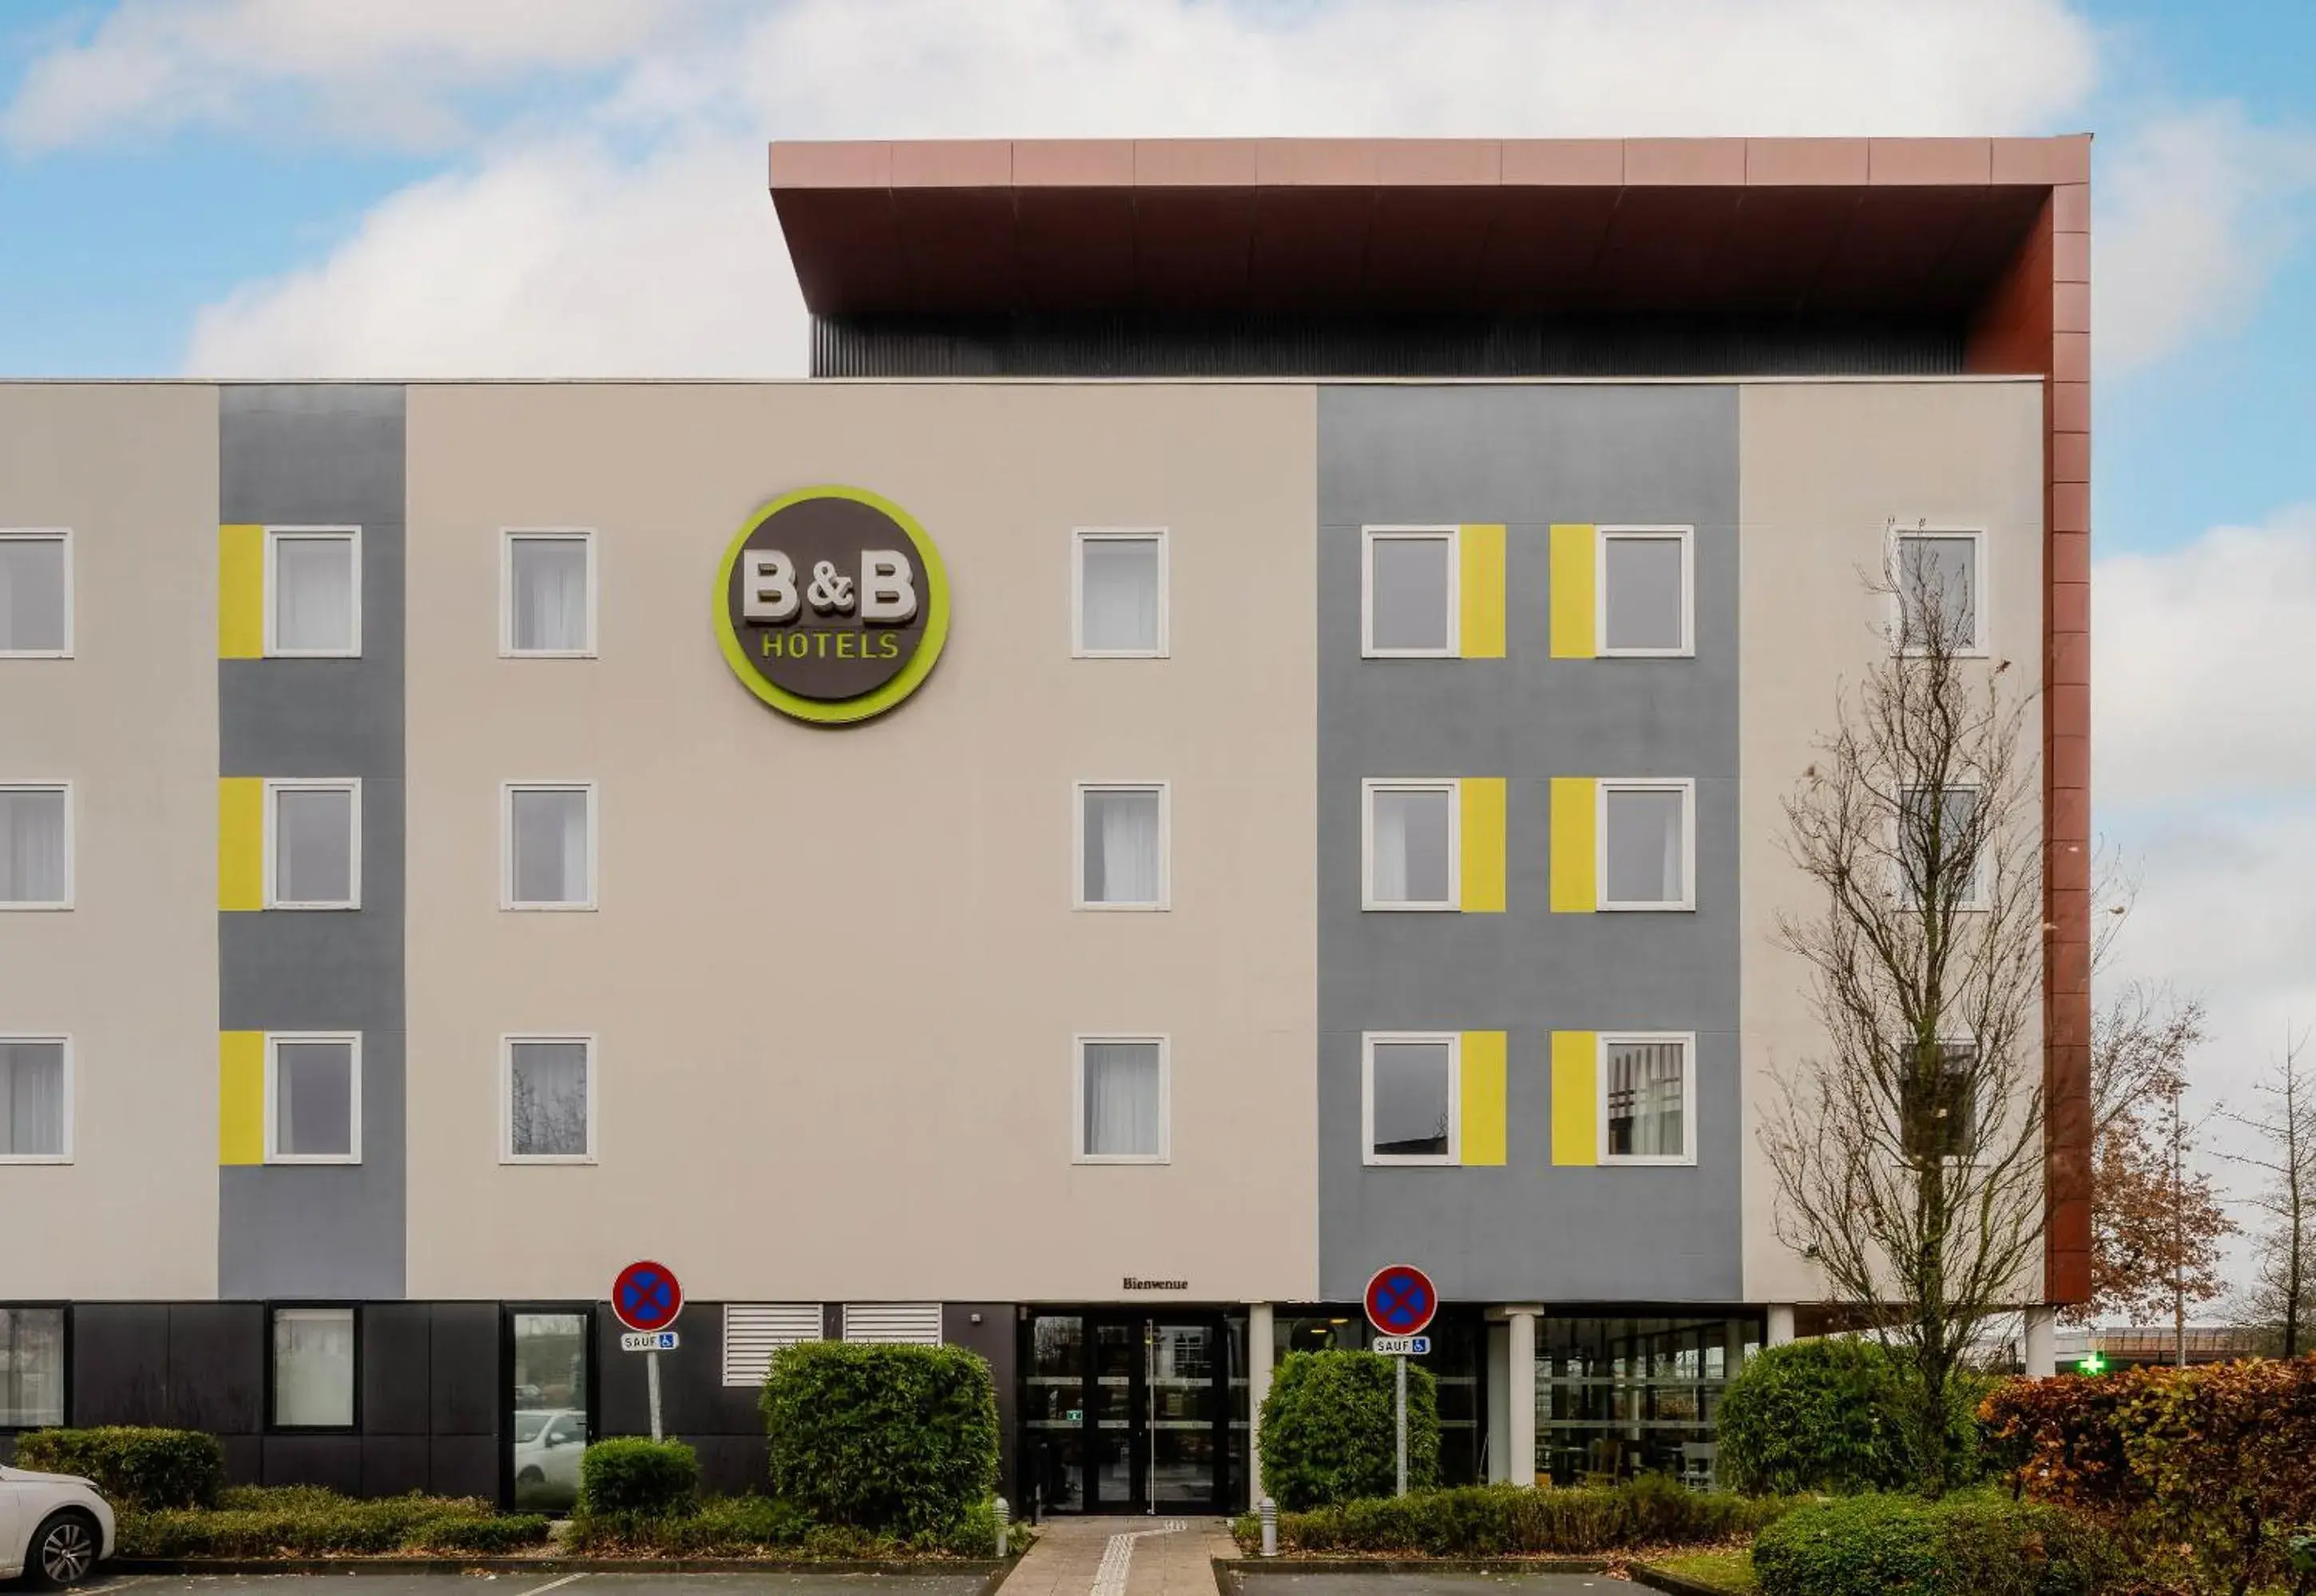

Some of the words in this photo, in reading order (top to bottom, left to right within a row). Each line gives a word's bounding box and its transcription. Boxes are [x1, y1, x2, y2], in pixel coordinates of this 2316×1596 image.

[744, 549, 918, 624] B&B
[762, 632, 899, 659] HOTELS
[1123, 1277, 1188, 1289] Bienvenue
[625, 1336, 656, 1348] SAUF
[1378, 1341, 1408, 1351] SAUF
